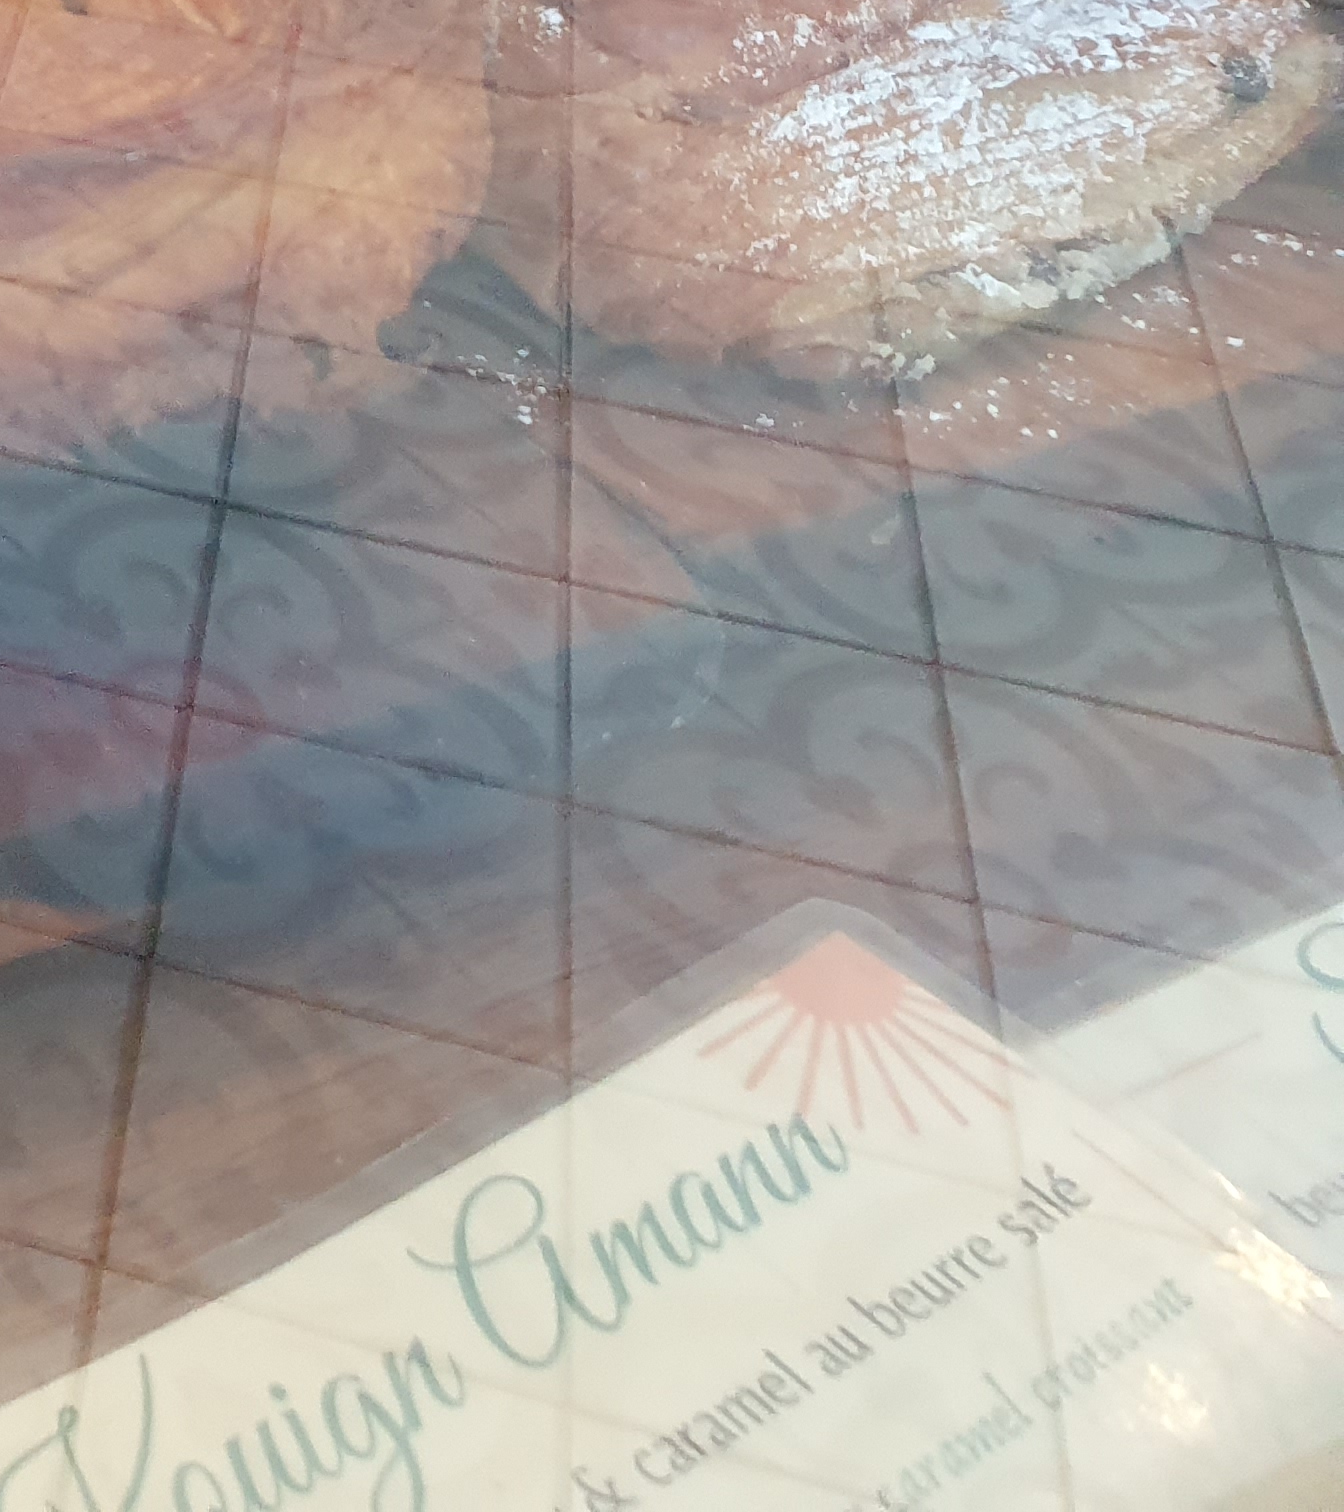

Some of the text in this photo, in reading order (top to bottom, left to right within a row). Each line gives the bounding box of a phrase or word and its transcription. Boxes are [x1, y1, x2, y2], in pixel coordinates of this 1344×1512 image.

[407, 1113, 849, 1369] Amann
[632, 1348, 813, 1487] caramel
[805, 1324, 875, 1379] au
[846, 1233, 1009, 1338] beurre
[997, 1162, 1093, 1247] salé
